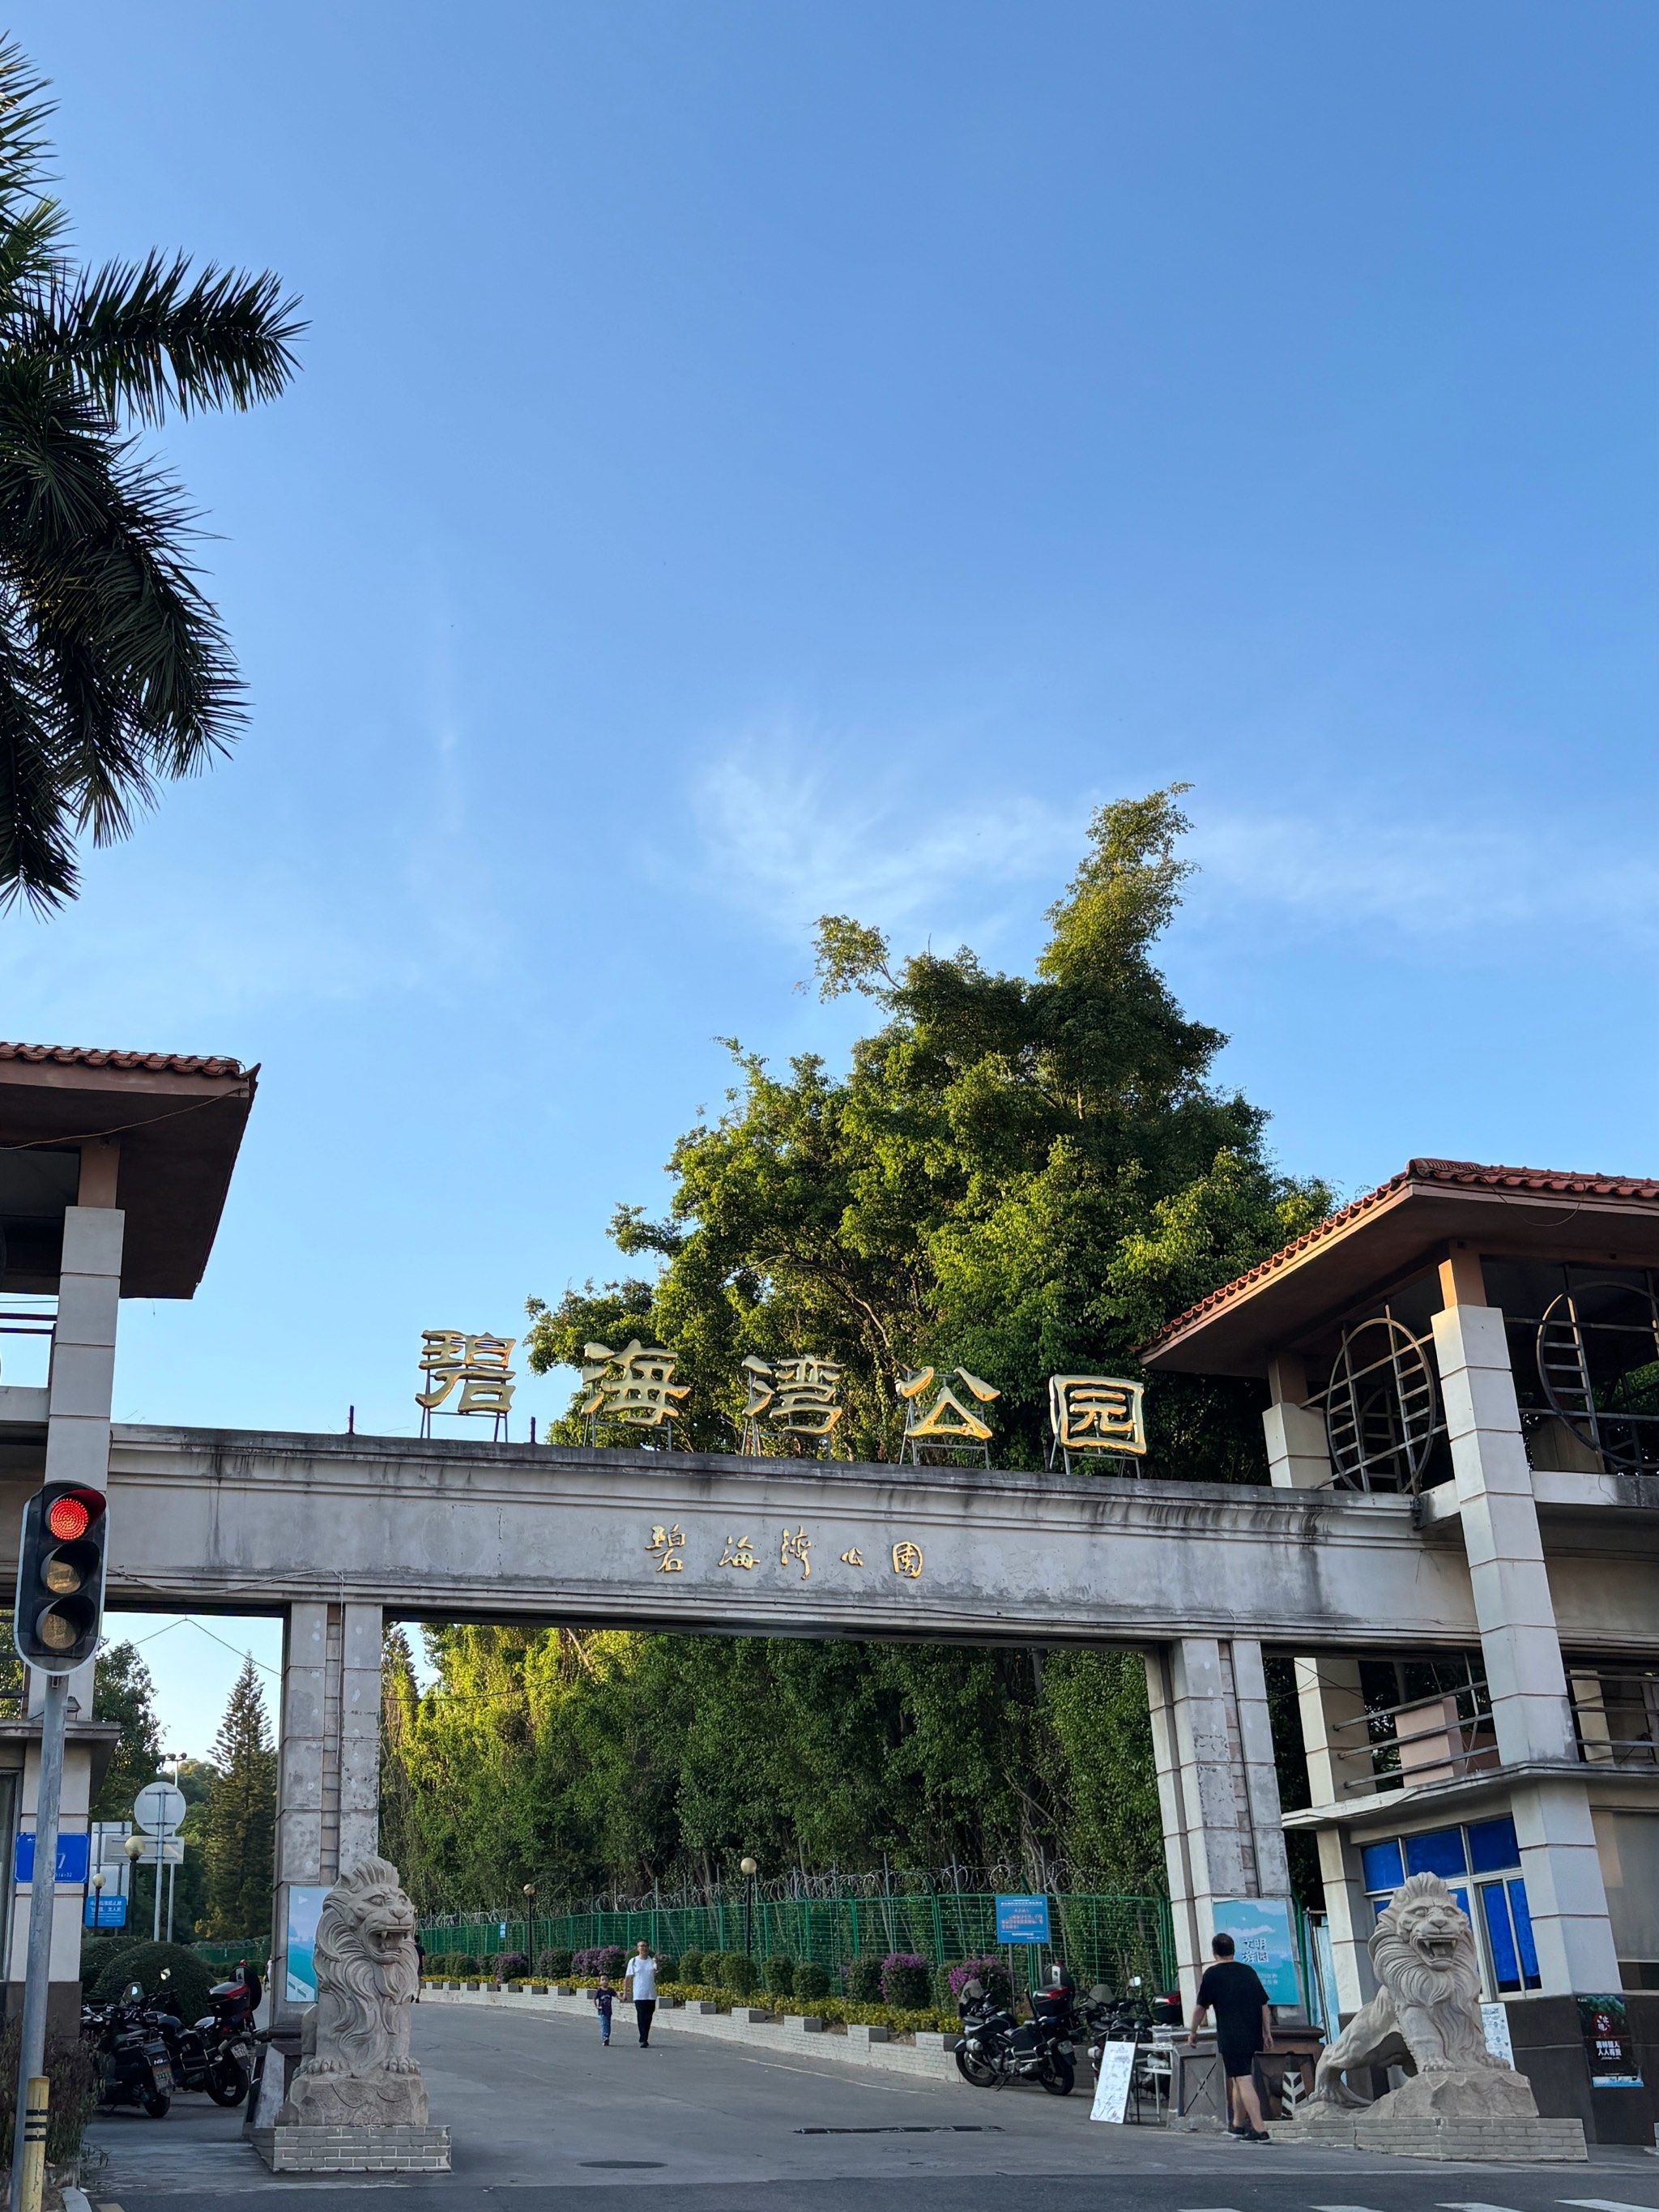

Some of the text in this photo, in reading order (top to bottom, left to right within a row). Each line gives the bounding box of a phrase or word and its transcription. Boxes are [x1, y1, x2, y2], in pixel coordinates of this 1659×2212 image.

[415, 1329, 1147, 1455] 碧海湾公园
